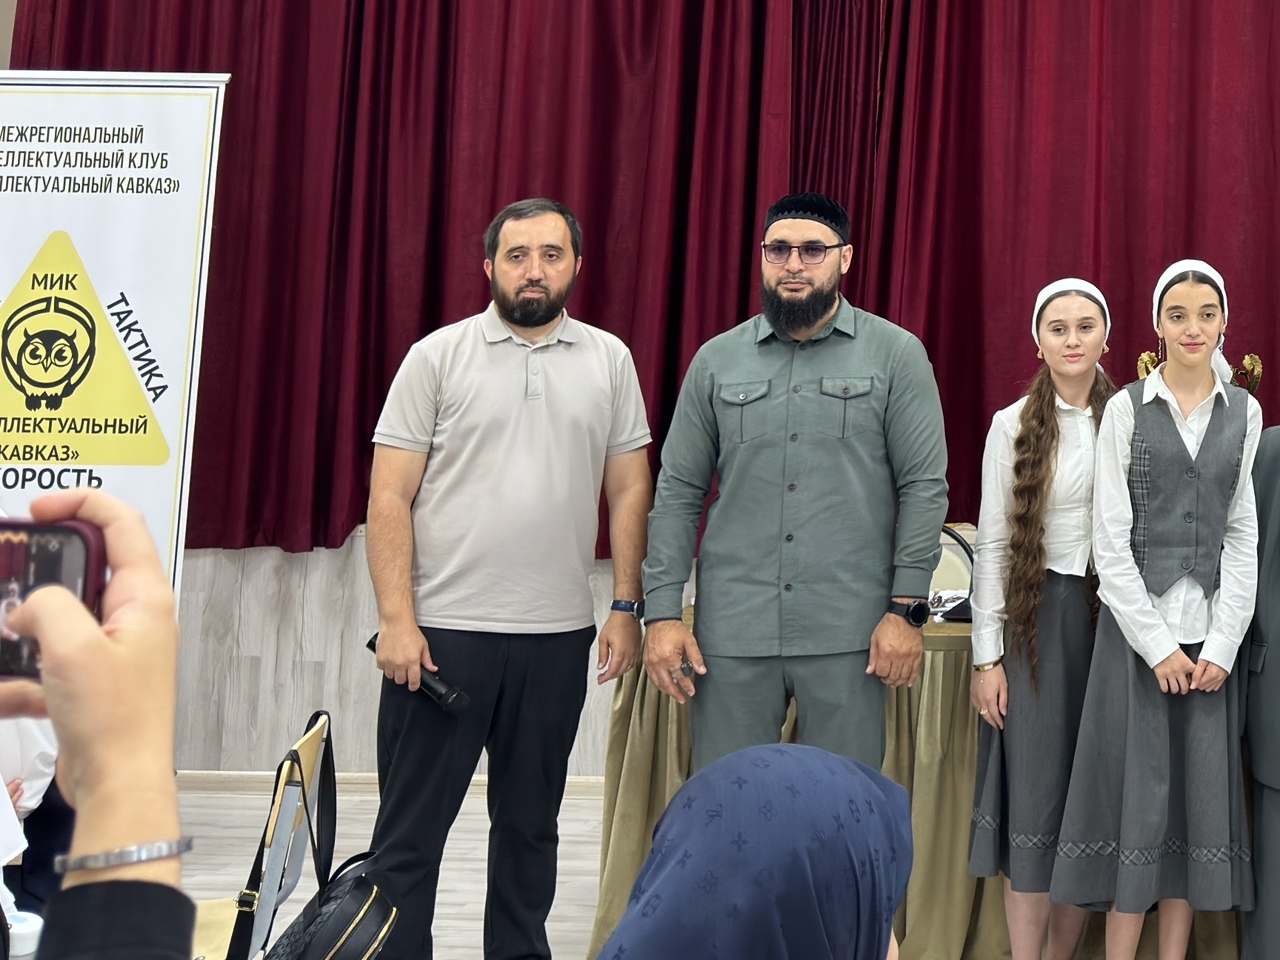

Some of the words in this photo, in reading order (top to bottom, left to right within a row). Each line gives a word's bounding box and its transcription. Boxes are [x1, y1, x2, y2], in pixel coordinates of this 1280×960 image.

[128, 152, 168, 169] КЛУБ
[0, 174, 113, 193] ЛЕКТУАЛЬНЫЙ
[116, 177, 180, 194] КАВКАЗ»
[31, 273, 78, 291] МИК
[106, 291, 169, 403] ТАКТИКА
[0, 468, 103, 490] ОРОСТЬ
